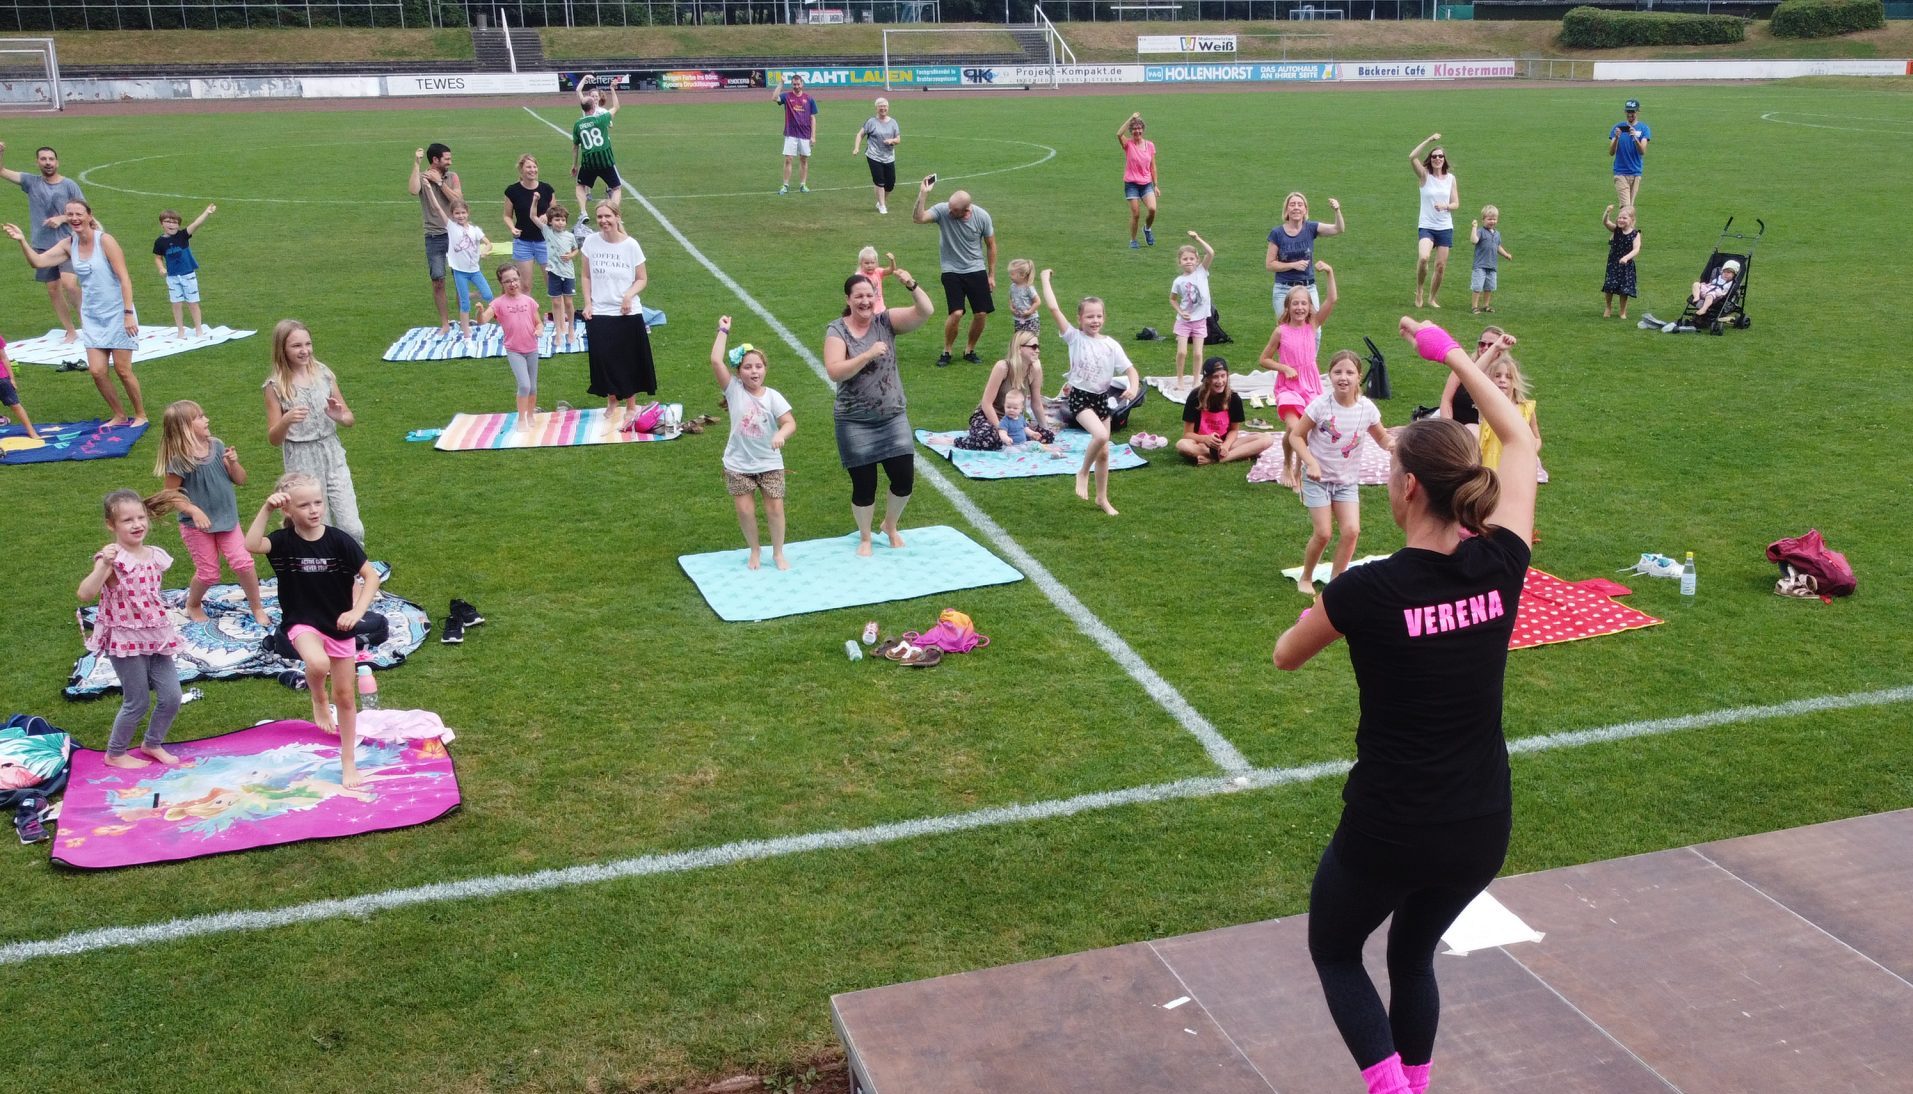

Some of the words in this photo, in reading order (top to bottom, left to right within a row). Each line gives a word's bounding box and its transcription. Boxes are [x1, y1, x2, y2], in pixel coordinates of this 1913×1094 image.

[1199, 41, 1234, 51] Weiß
[1165, 66, 1253, 80] HOLLENHORST
[1278, 65, 1318, 73] AUTOHAUS
[1358, 66, 1400, 76] Bäckerei
[1404, 65, 1425, 76] Café
[1434, 64, 1514, 77] Klostermann
[1299, 71, 1318, 79] SEITE
[416, 78, 465, 90] TEWES
[580, 127, 604, 150] 08
[592, 252, 620, 260] COFFEE
[593, 260, 630, 269] CUPCAKES
[1403, 590, 1504, 637] VERENA
